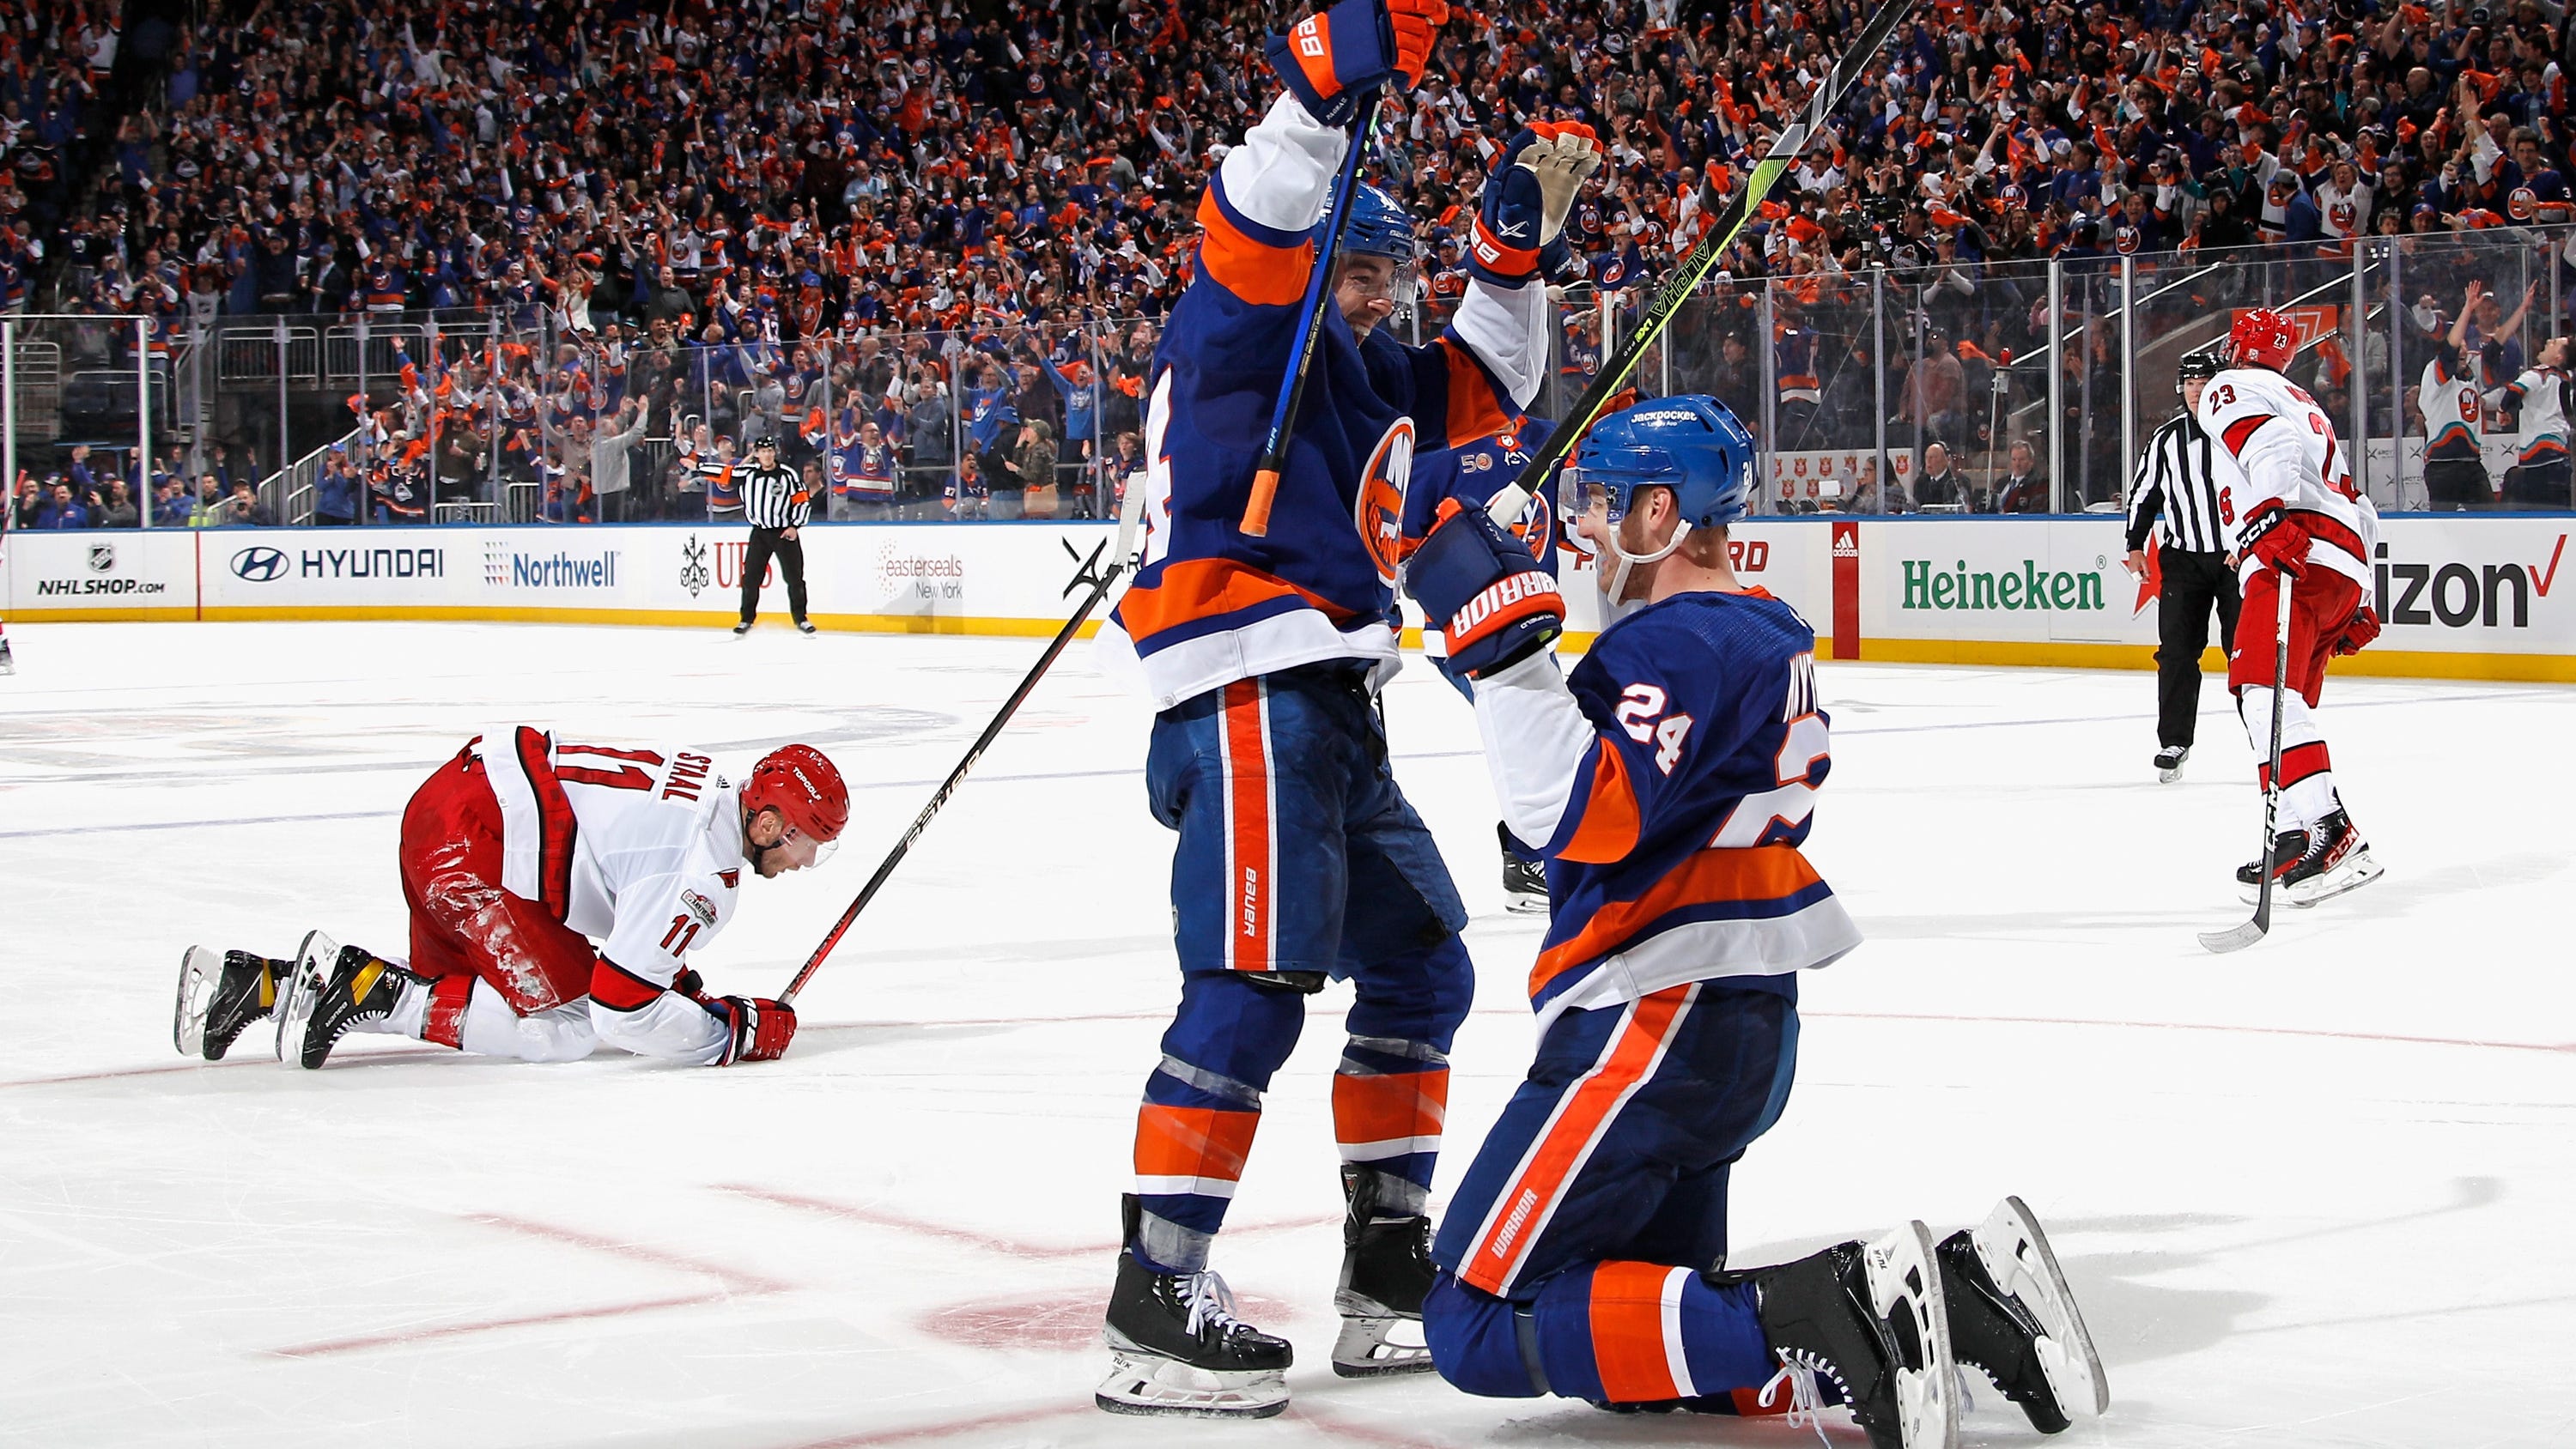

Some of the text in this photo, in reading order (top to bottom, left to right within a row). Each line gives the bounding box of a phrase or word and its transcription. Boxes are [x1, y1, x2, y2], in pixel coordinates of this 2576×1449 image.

[2273, 332, 2287, 349] 23
[2209, 384, 2237, 417] 23
[2239, 511, 2277, 549] CCM
[301, 549, 444, 578] HYUNDAI
[513, 550, 616, 587] Northwell
[886, 554, 963, 577] easterseals
[1832, 548, 1859, 558] adidas
[915, 581, 963, 599] New York
[1901, 560, 2105, 610] Heineken
[2374, 543, 2529, 627] izon
[1453, 570, 1558, 639] ARRIOR
[1614, 682, 1695, 778] 24
[662, 752, 712, 802] STAAL
[793, 767, 822, 801] TOPGOLF
[659, 913, 702, 958] 11
[1491, 1187, 1540, 1260] WARRIOR
